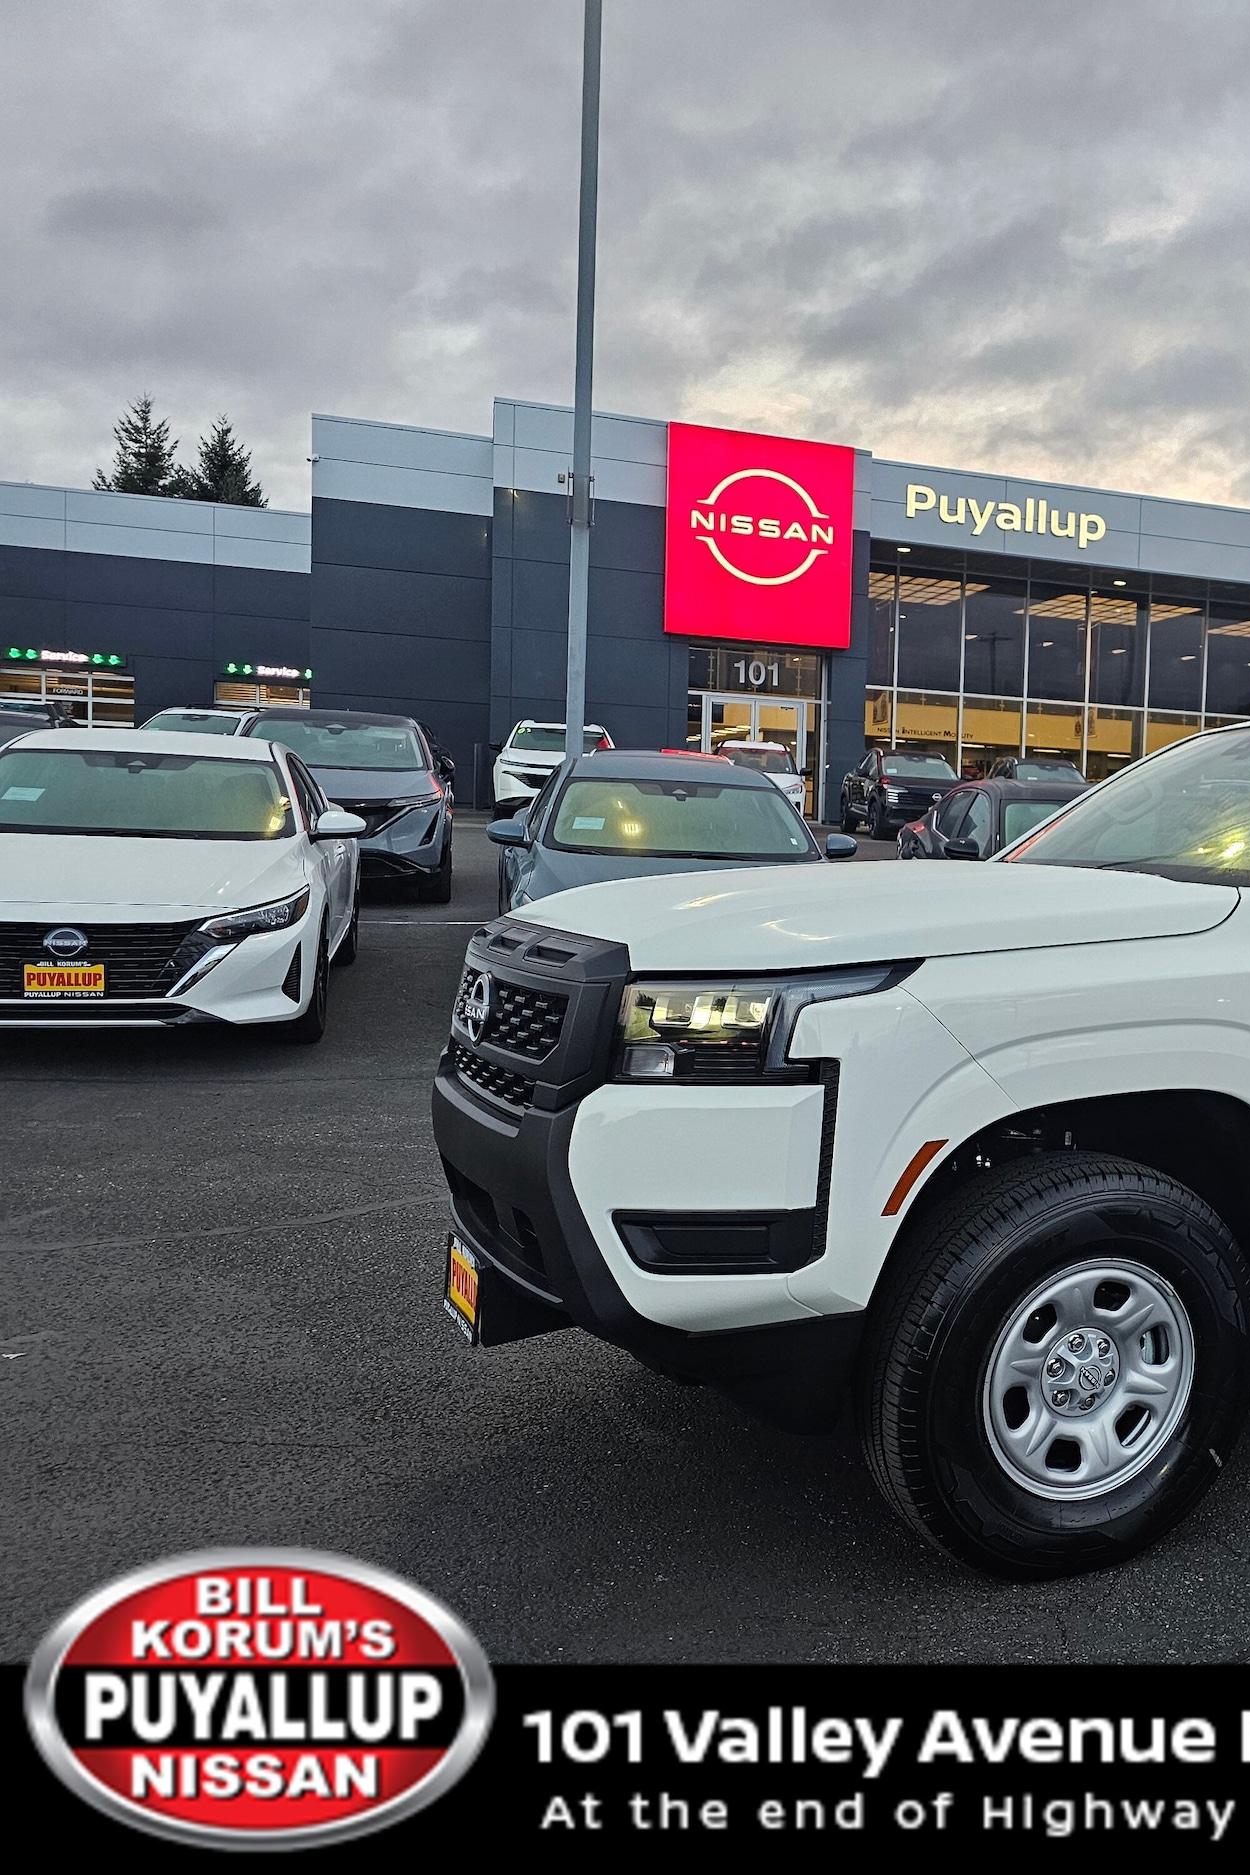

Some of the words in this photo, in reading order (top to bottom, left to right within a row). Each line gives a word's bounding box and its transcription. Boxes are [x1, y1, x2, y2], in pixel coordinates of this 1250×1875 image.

[690, 509, 835, 545] NISSAN
[906, 484, 1107, 549] Puyallup
[257, 665, 300, 678] Service
[733, 659, 779, 687] 101
[43, 939, 88, 947] NISSAN
[26, 972, 102, 987] PUYALLUP
